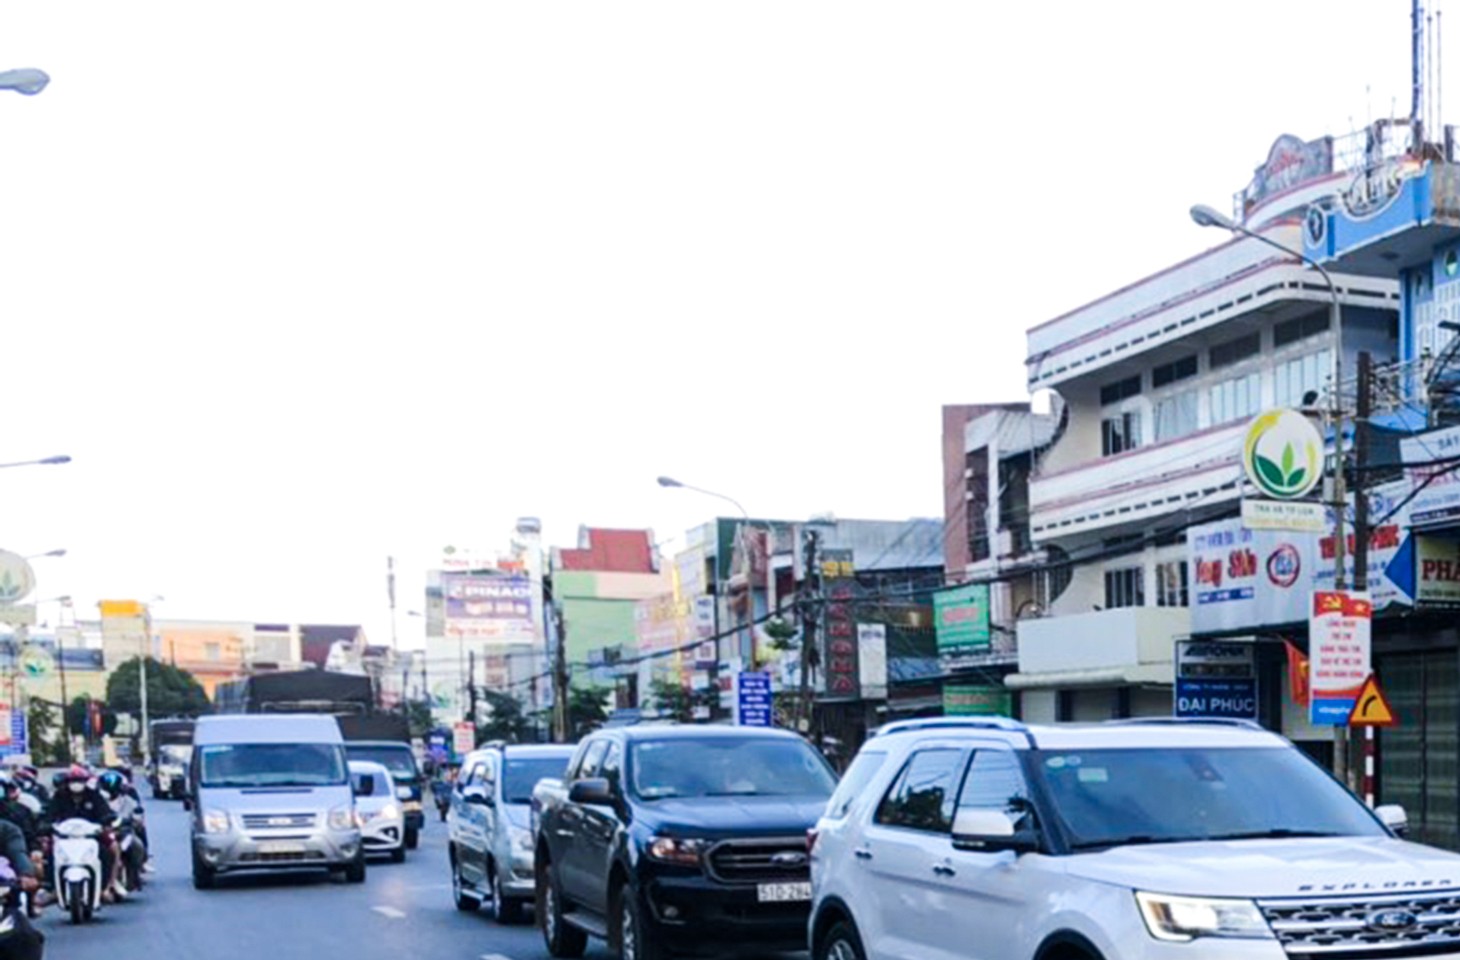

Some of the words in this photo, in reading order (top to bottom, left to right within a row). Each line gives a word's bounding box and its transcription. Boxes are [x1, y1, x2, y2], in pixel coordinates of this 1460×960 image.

[1178, 697, 1206, 714] ĐẠI
[1210, 693, 1254, 712] PHÚC
[1298, 879, 1452, 892] EXPLORER
